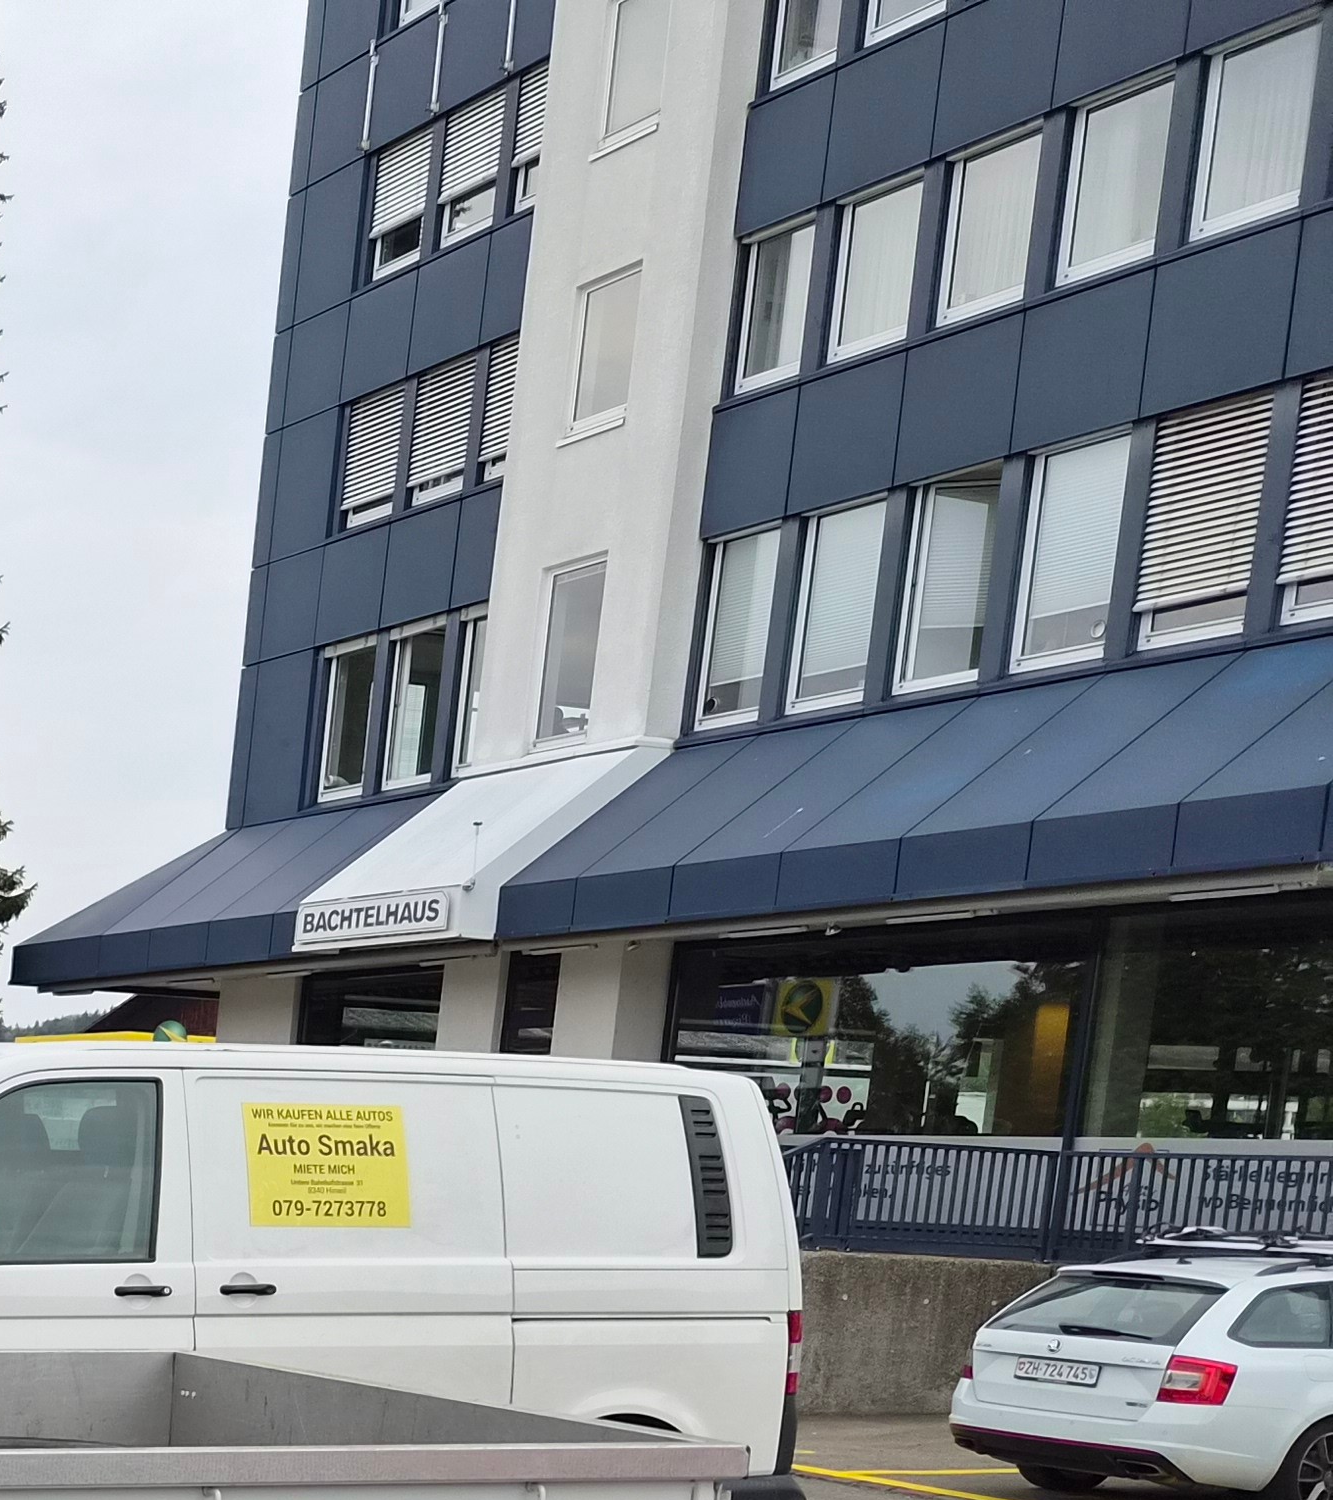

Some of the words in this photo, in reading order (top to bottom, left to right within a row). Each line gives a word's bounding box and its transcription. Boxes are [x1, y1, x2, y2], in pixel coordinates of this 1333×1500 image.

[302, 899, 440, 934] BACHTELHAUS
[251, 1108, 274, 1119] WIR
[277, 1109, 323, 1120] KAUFEN
[326, 1110, 353, 1121] ALLE
[356, 1110, 393, 1122] AUTOS
[257, 1133, 311, 1156] Auto
[318, 1133, 396, 1157] Smaka
[293, 1164, 325, 1174] MIETE
[328, 1164, 355, 1175] MICH
[272, 1200, 387, 1218] 079-7273778
